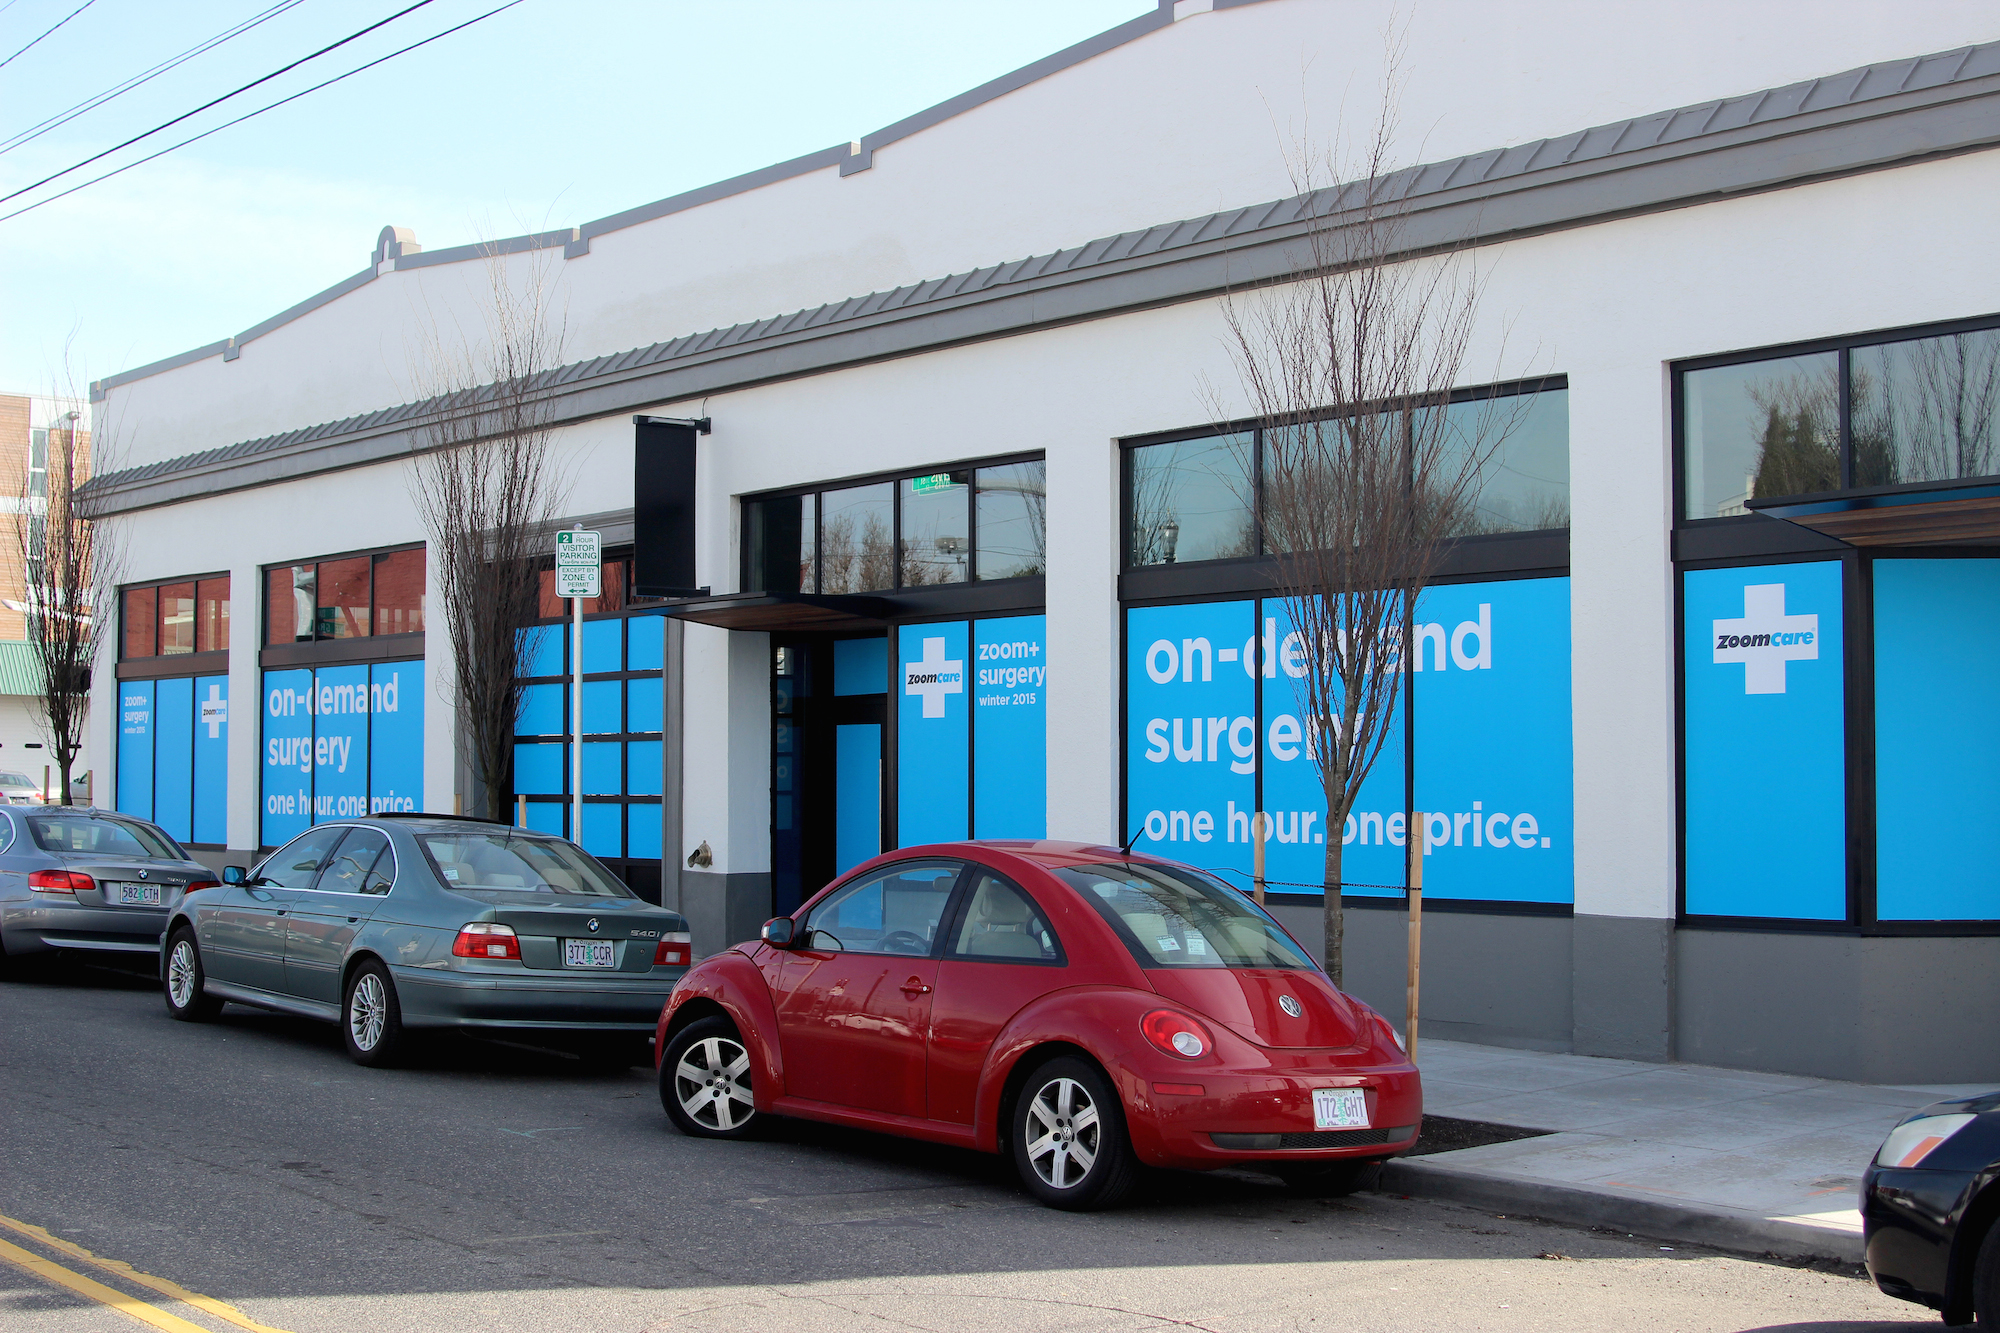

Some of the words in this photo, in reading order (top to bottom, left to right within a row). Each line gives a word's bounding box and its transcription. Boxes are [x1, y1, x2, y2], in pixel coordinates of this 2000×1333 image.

[562, 534, 569, 543] 2
[560, 552, 597, 560] PARKING
[979, 641, 1040, 660] zoom+
[979, 666, 1046, 688] surgery
[269, 672, 399, 717] on-demand
[979, 694, 1010, 706] winter
[1012, 693, 1036, 705] 2015
[124, 711, 149, 724] surgery
[268, 736, 352, 773] surgery
[268, 794, 295, 815] one
[299, 789, 336, 816] hour.
[337, 795, 367, 816] one
[1144, 810, 1215, 843] one
[1227, 800, 1323, 844] hour.
[1341, 810, 1406, 846] one
[1423, 801, 1551, 856] price.
[123, 886, 139, 898] 582
[143, 888, 159, 900] CTH
[630, 929, 660, 938] 540i
[568, 945, 586, 959] 377
[593, 946, 612, 960] CCR
[1318, 1097, 1339, 1119] 172
[1344, 1096, 1364, 1118] GHT
